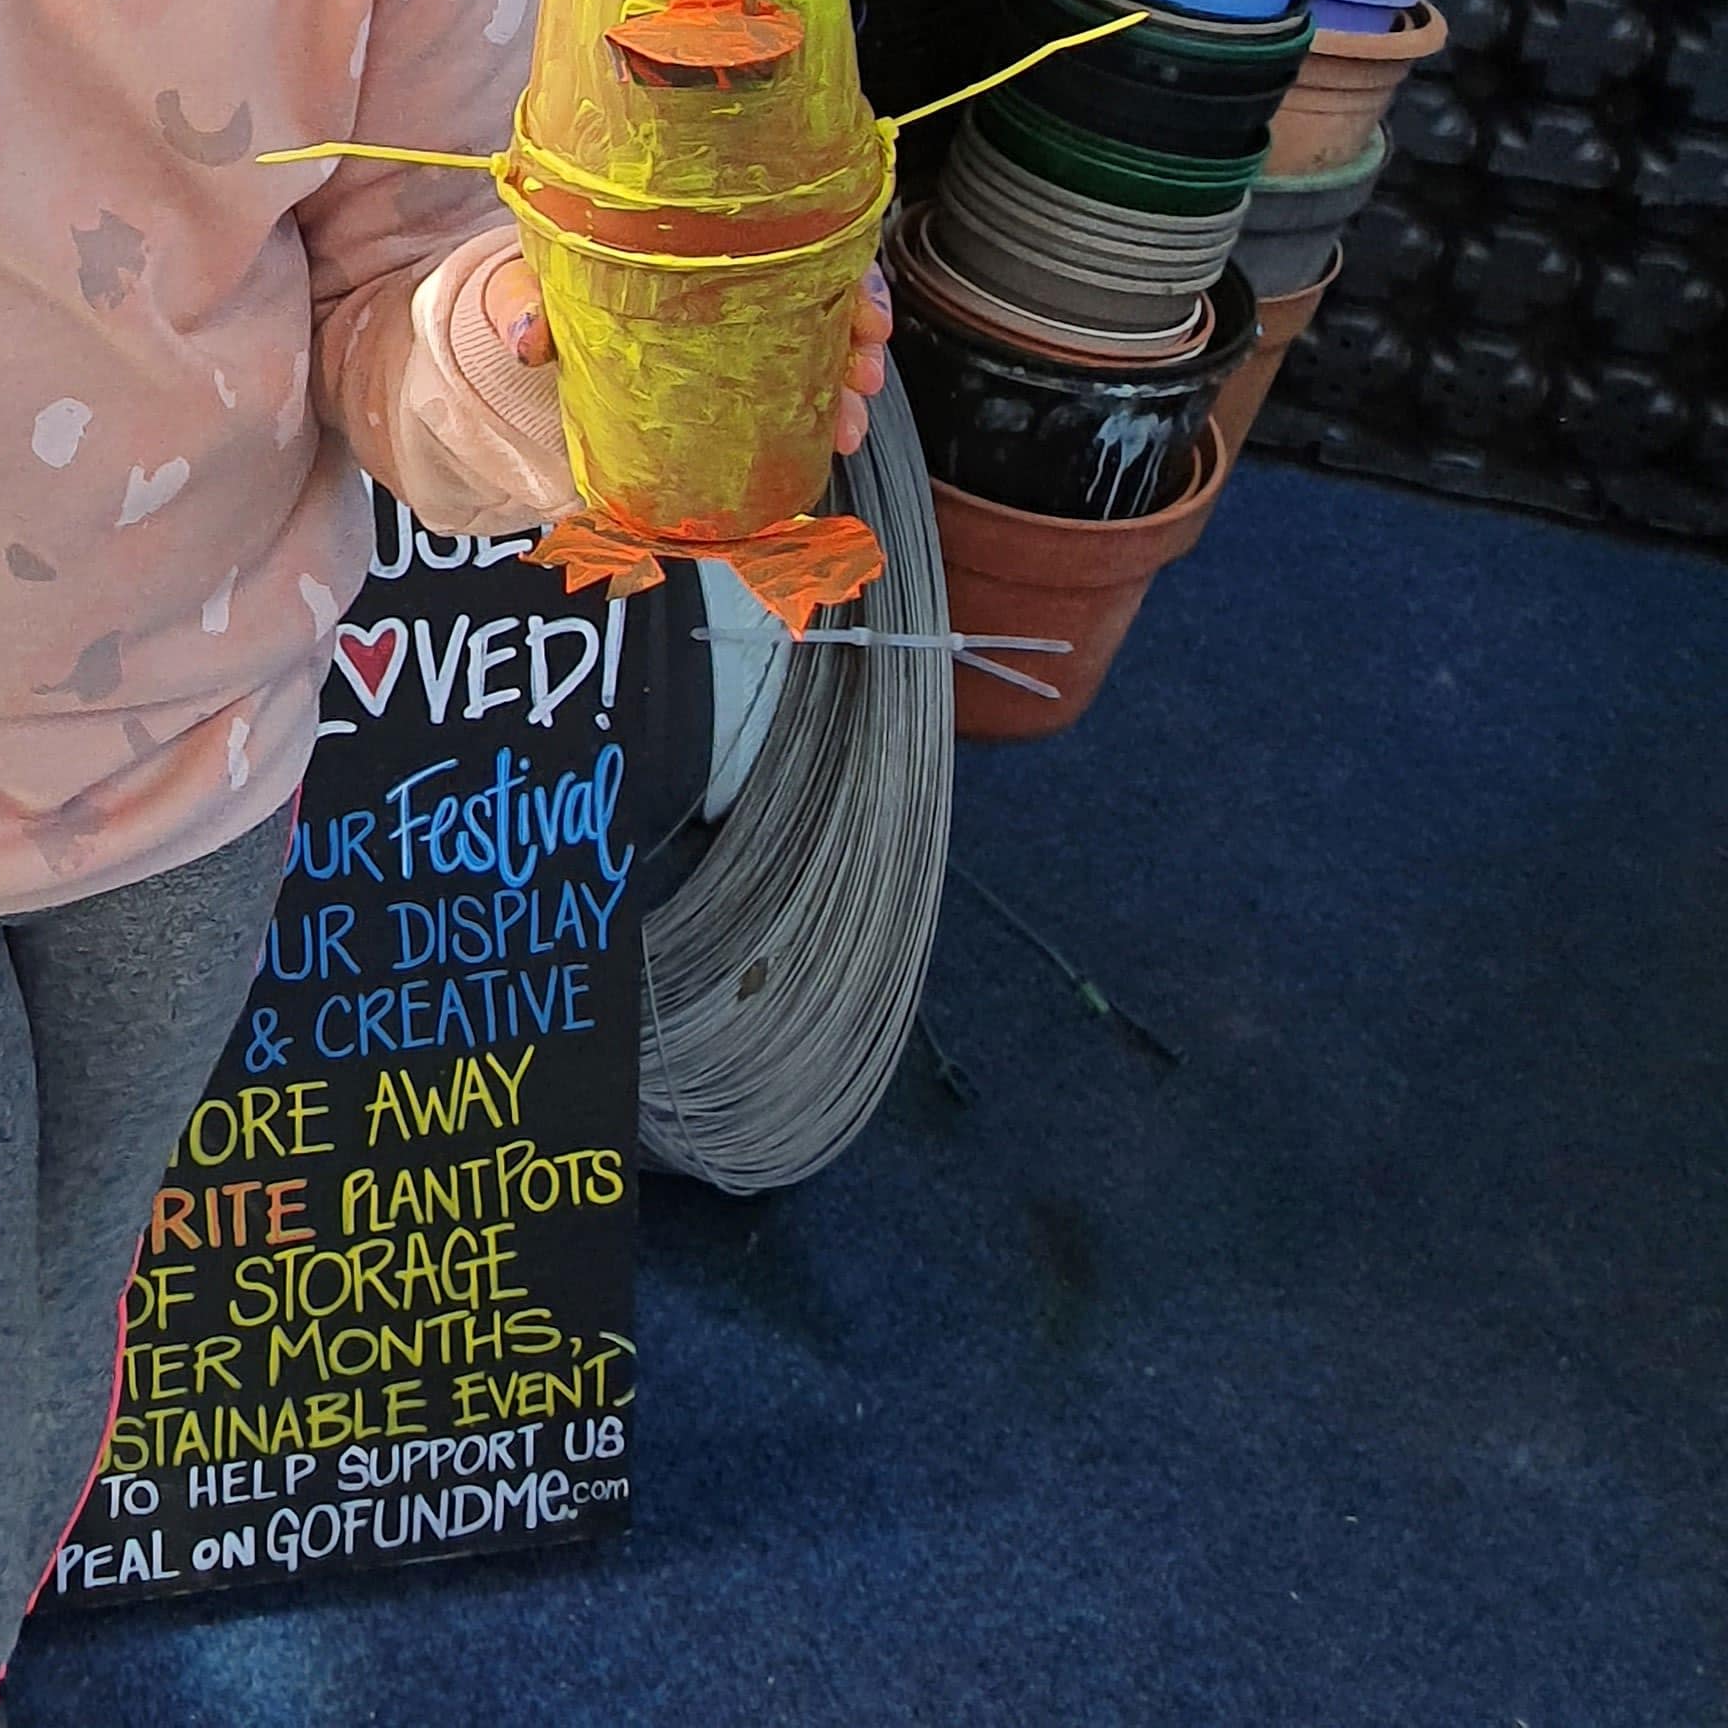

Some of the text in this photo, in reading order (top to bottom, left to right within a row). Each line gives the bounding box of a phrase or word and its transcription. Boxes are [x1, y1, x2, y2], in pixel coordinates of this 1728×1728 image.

[385, 743, 635, 888] Festival
[256, 903, 361, 980] UR
[387, 878, 627, 971] DISPLAY
[245, 1007, 294, 1073] &
[314, 964, 596, 1059] CREATIVE
[168, 1081, 335, 1168] ORE
[364, 1045, 535, 1147] AWAY
[228, 1222, 529, 1328] STORAGE
[269, 1309, 583, 1388] MONTHS,
[98, 1378, 428, 1474] STAINABLE
[100, 1472, 160, 1520] TO
[188, 1452, 316, 1510] HELP
[337, 1421, 544, 1493] SUPPORT
[564, 1415, 626, 1462] US
[192, 1524, 256, 1573] ON
